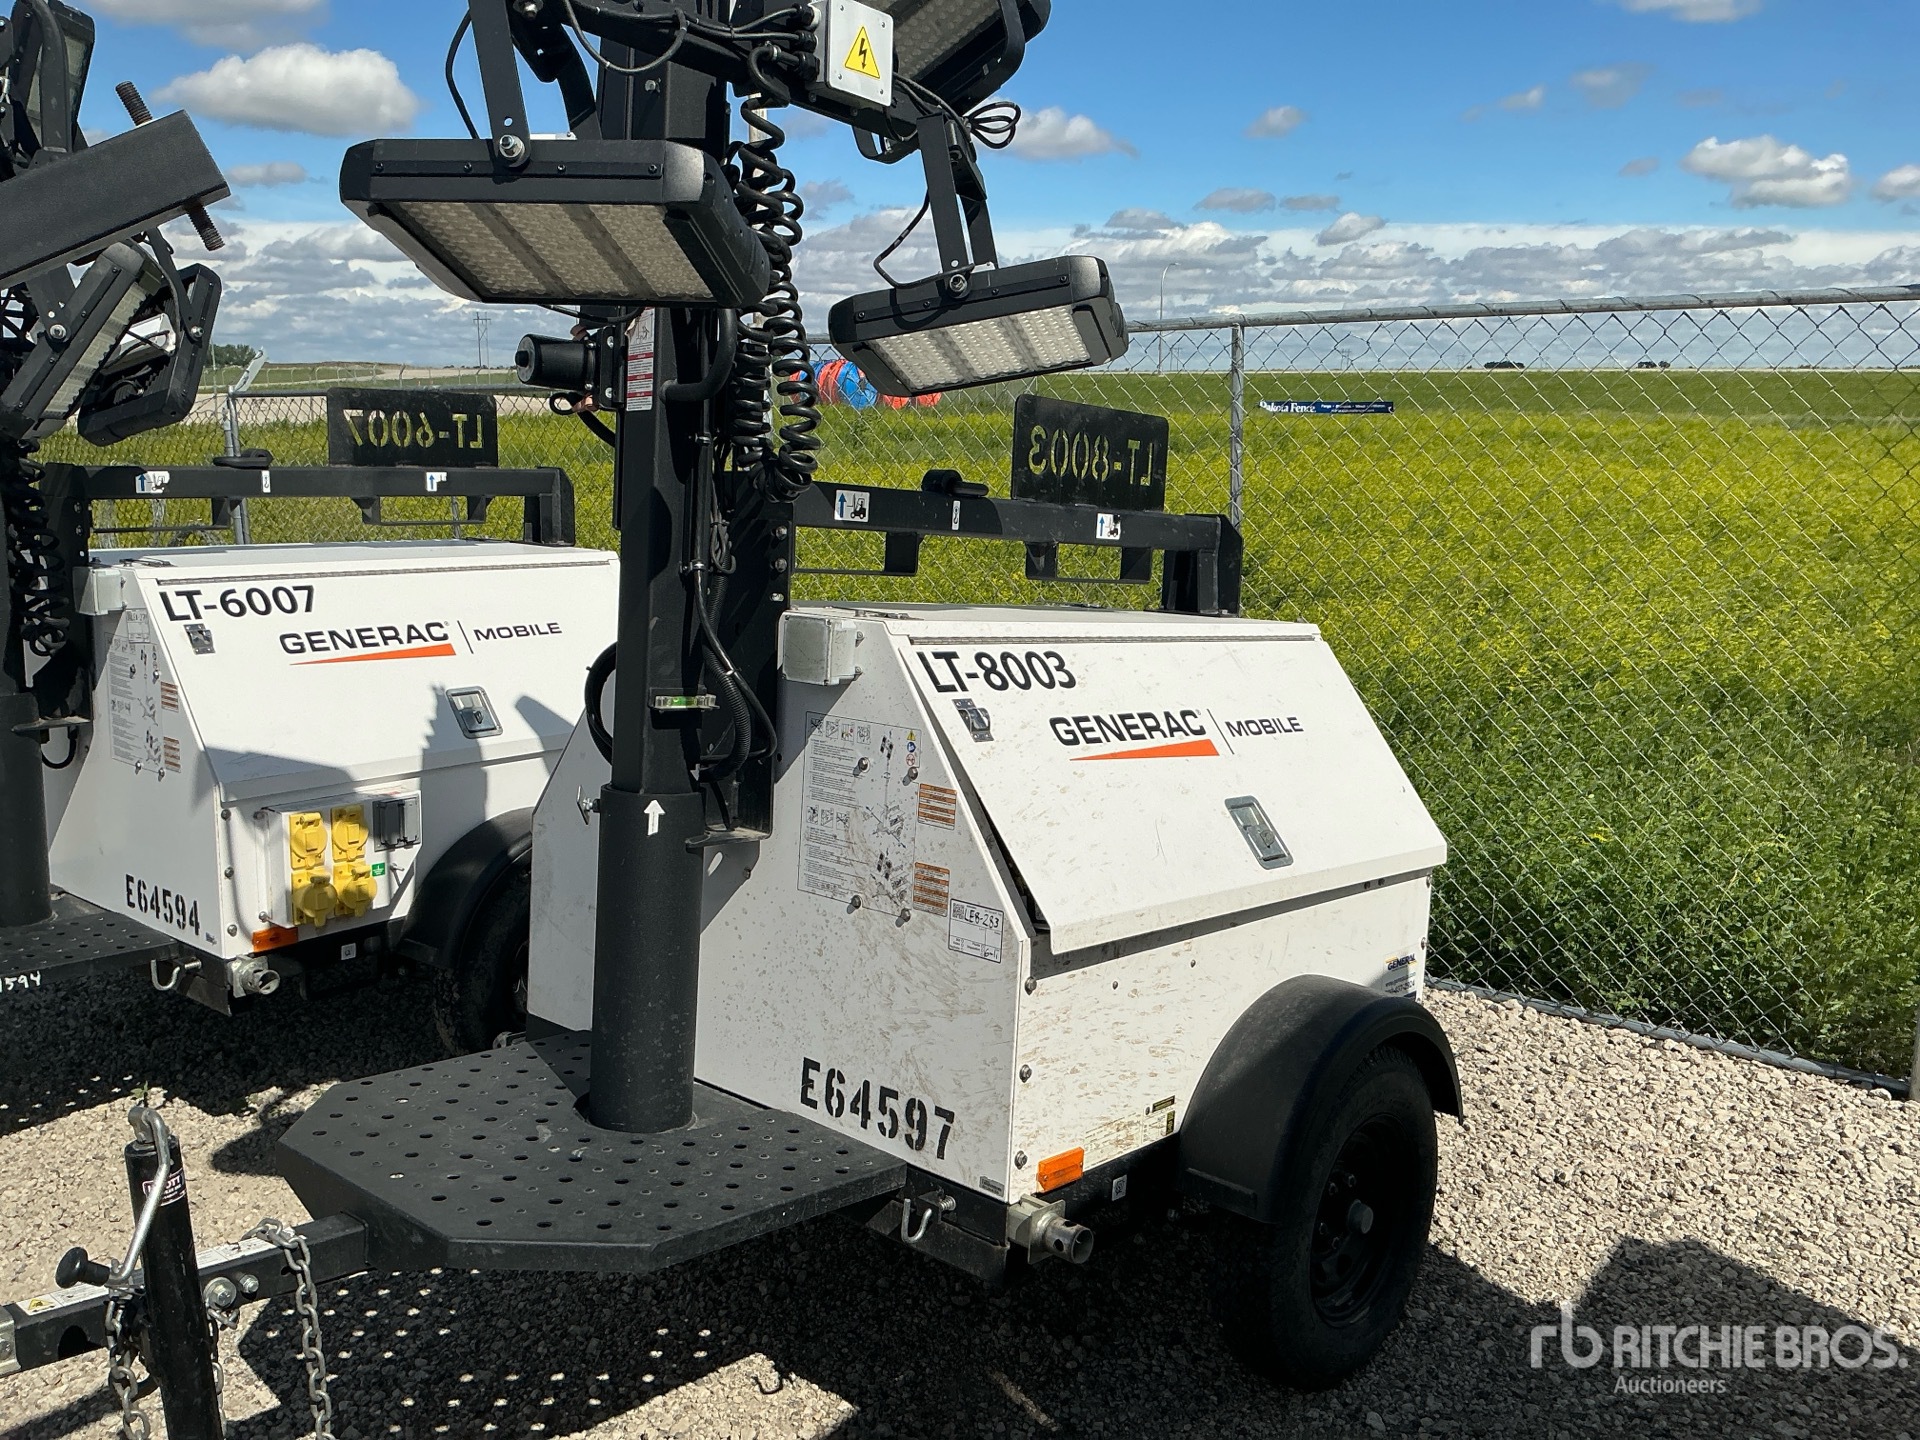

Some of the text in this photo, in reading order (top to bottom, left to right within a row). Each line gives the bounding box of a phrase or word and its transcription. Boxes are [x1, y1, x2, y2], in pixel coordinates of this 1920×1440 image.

[159, 584, 315, 622] LT-6007
[279, 621, 563, 655] GENERAC MOBILE
[916, 650, 1077, 693] LT-8003
[1049, 709, 1304, 747] GENERAC MOBILE
[125, 873, 201, 936] E64594
[800, 1056, 955, 1161] E64597
